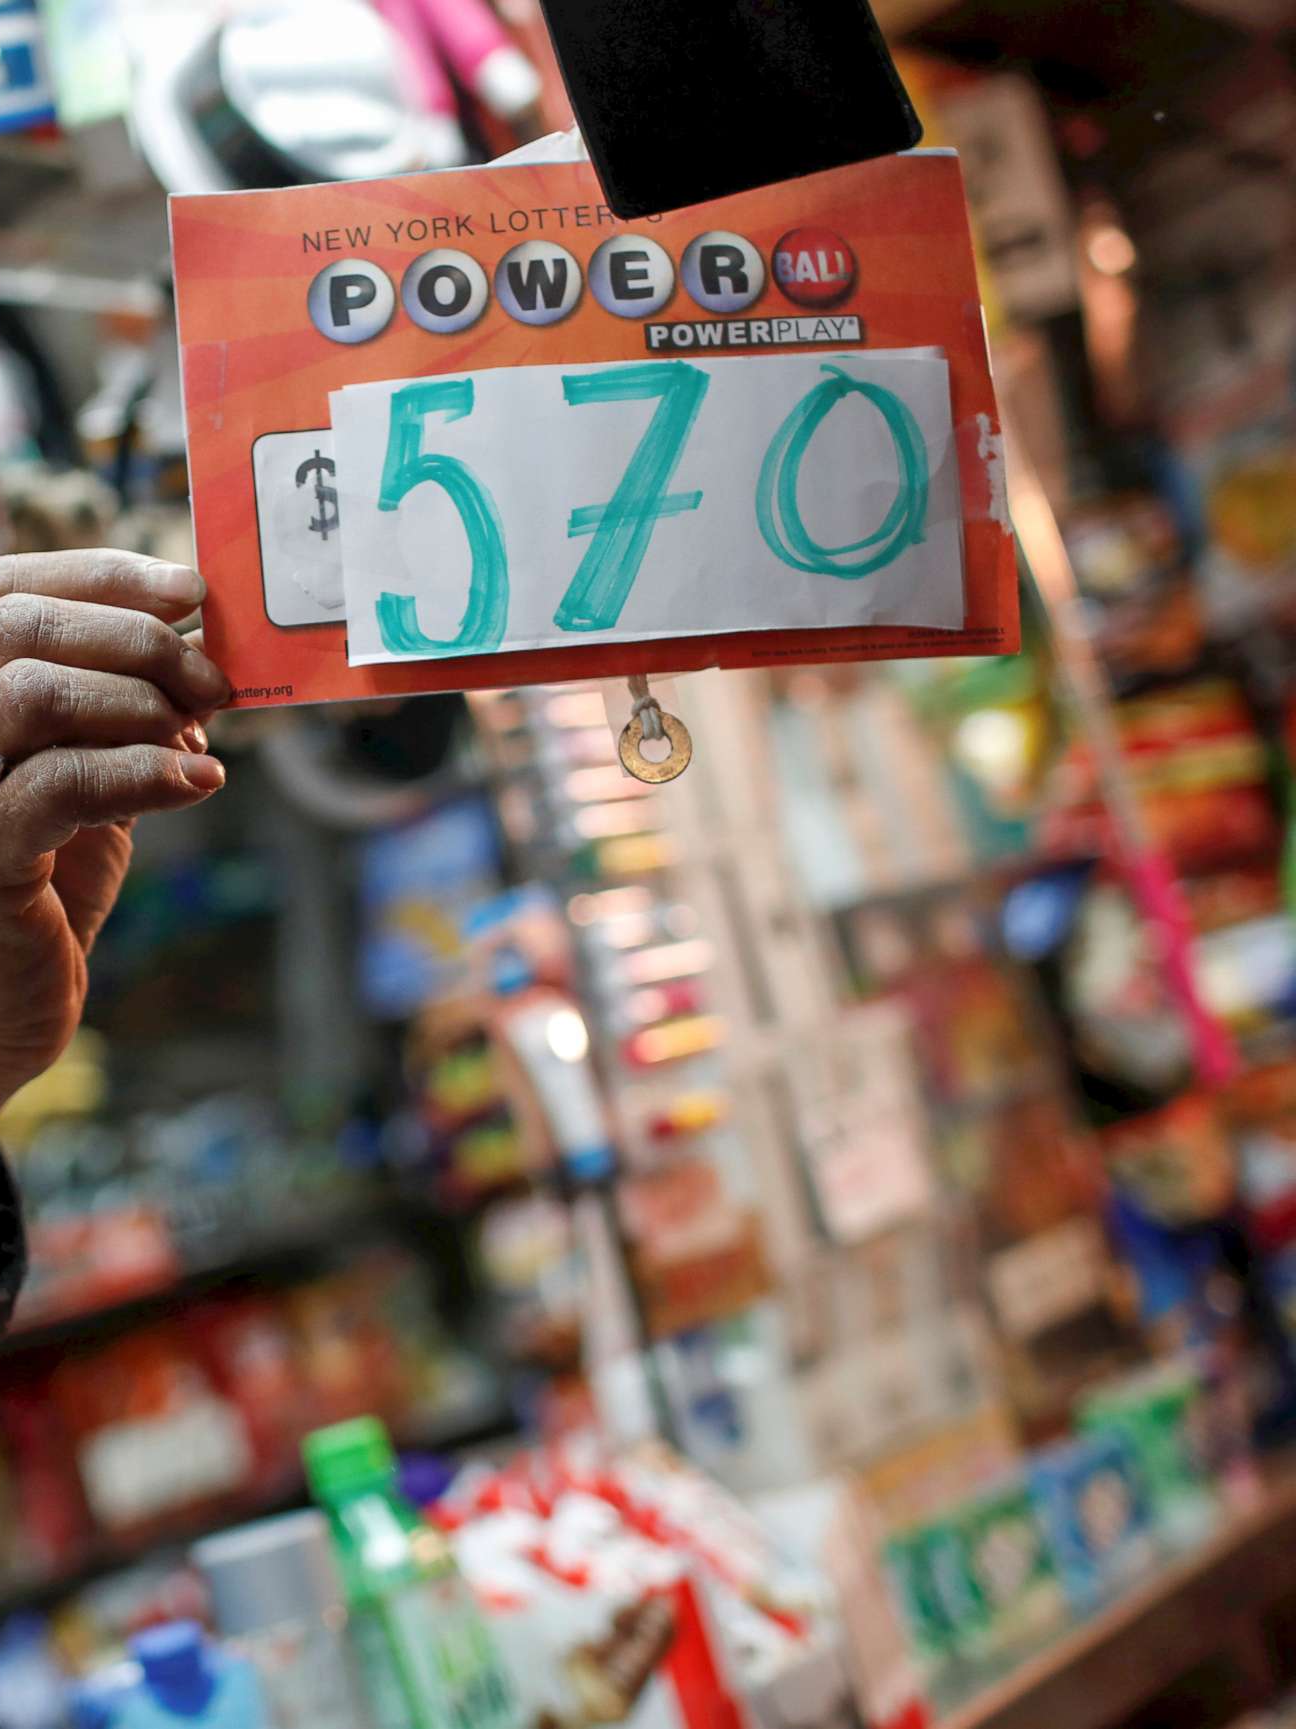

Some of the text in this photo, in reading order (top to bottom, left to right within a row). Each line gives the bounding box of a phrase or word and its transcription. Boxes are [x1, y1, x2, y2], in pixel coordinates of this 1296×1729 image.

[302, 225, 371, 253] NEW
[386, 214, 475, 242] YORK
[329, 244, 849, 327] POWER BALL
[375, 360, 929, 655] 570
